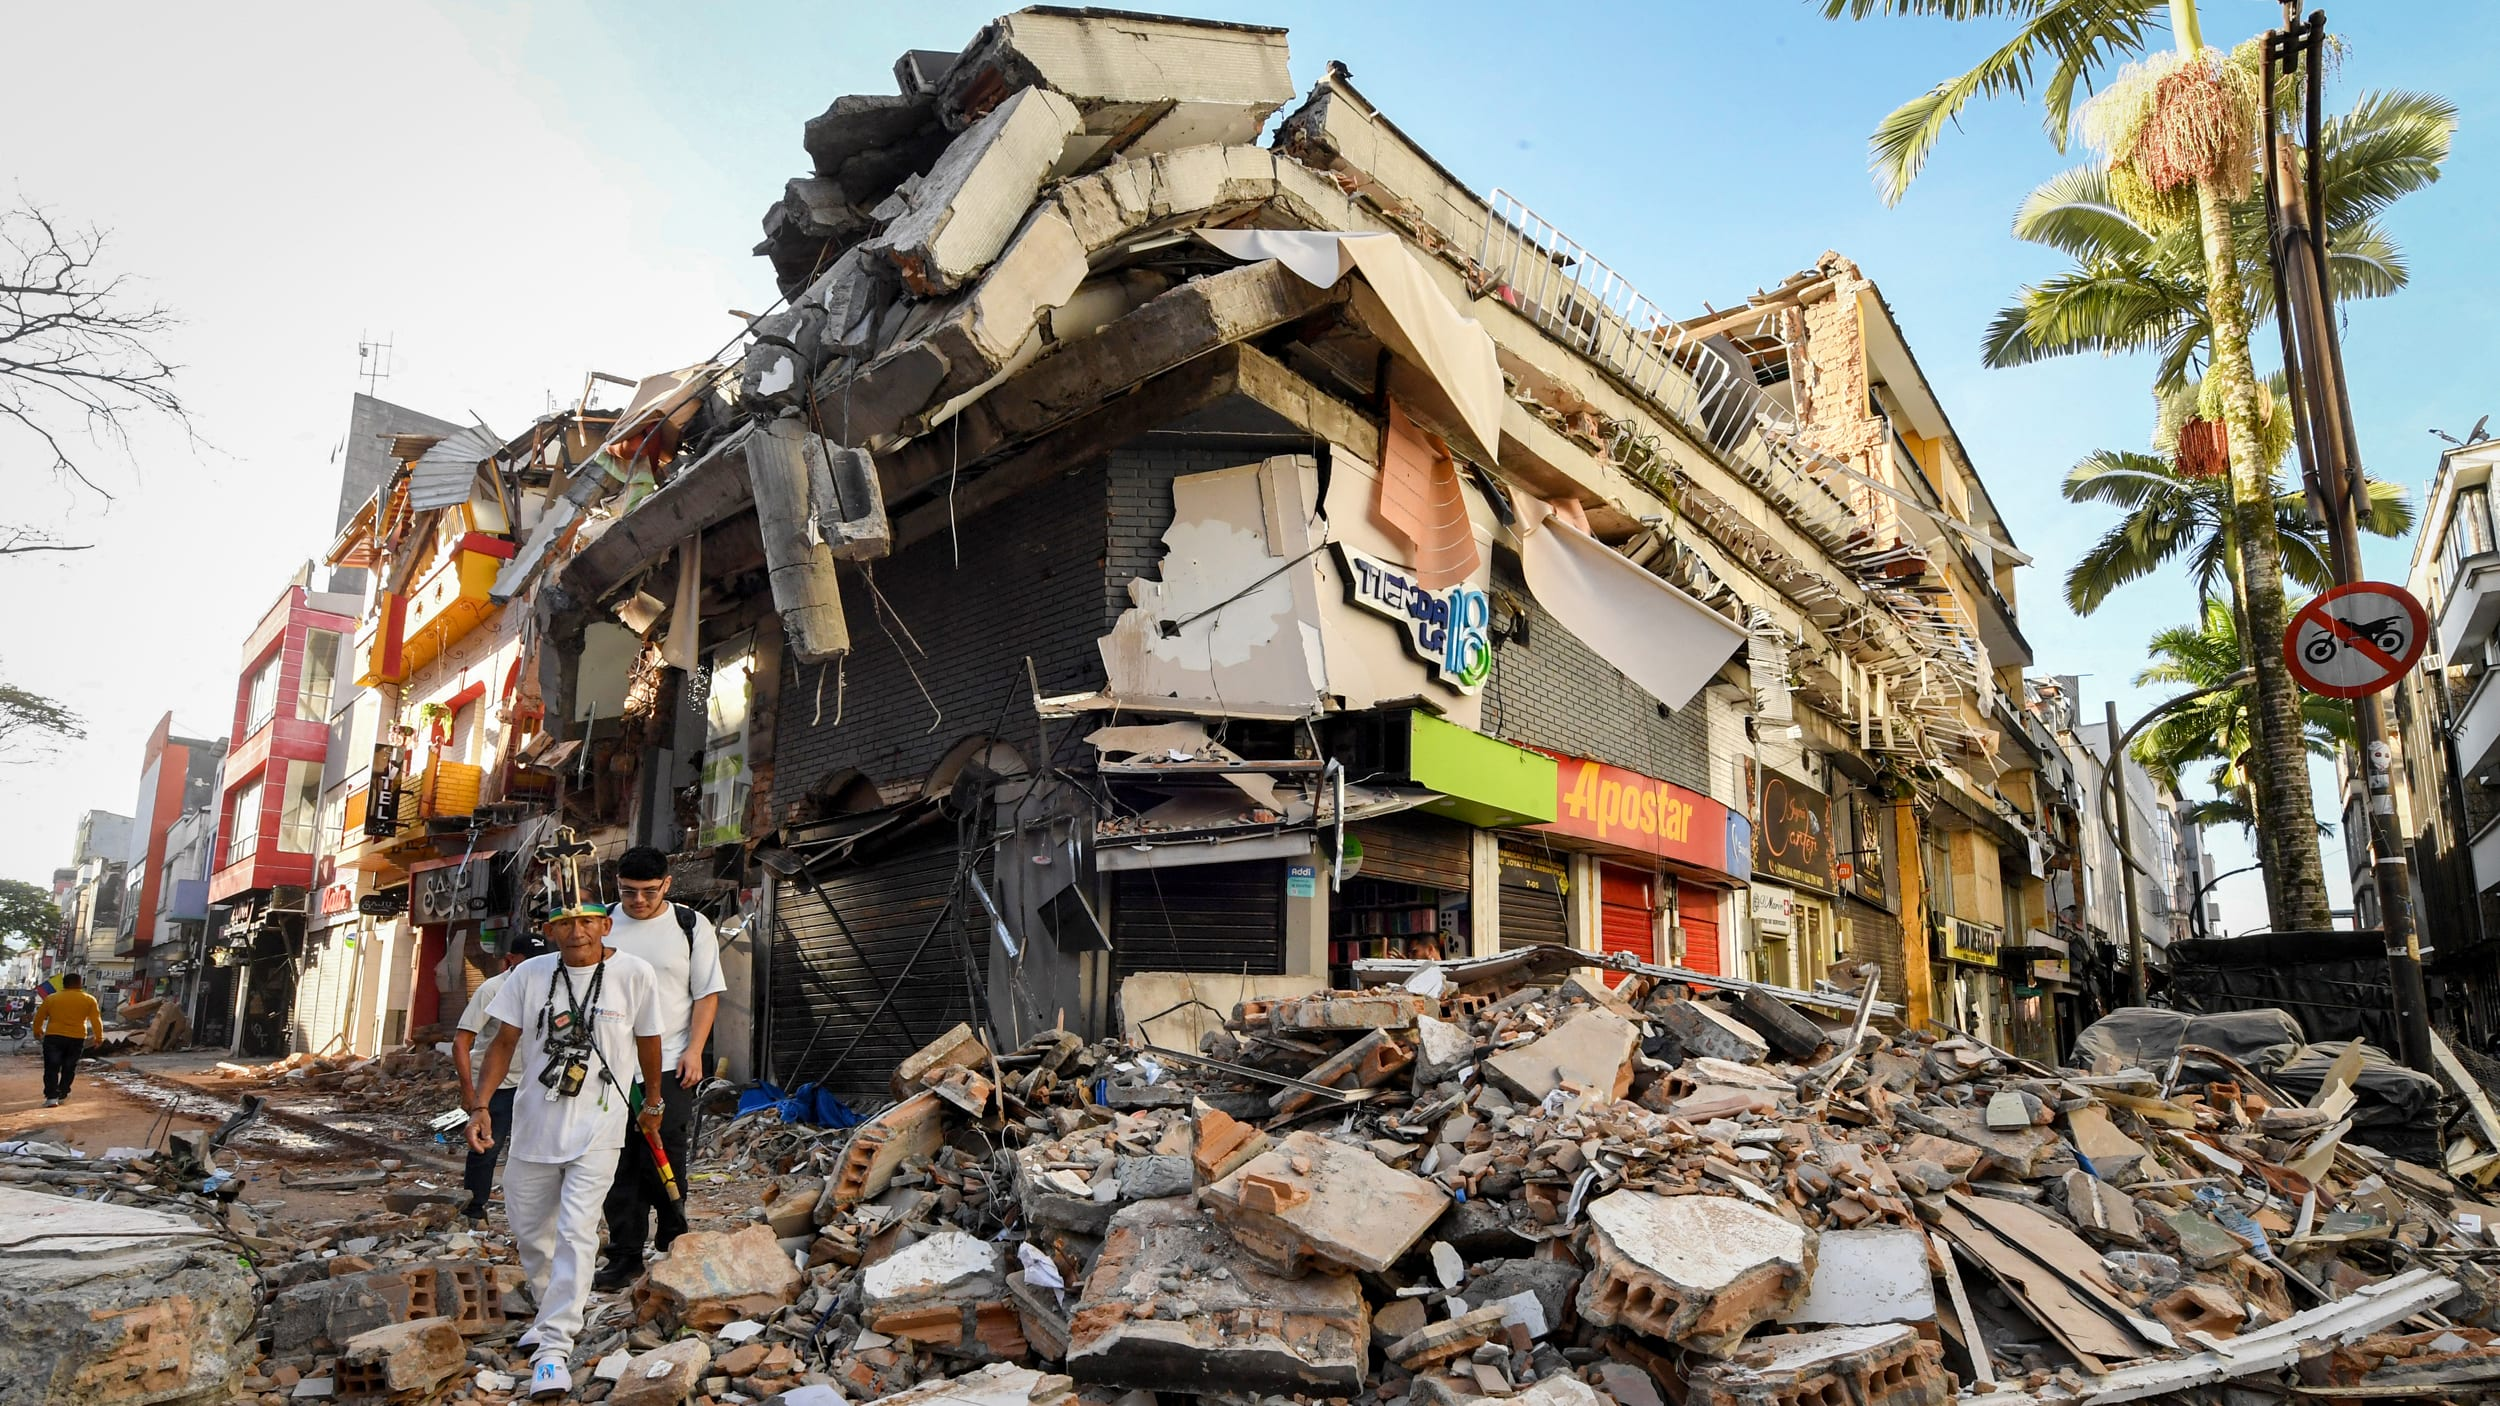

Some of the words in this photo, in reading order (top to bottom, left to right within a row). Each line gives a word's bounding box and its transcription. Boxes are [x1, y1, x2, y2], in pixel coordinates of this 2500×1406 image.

[1354, 558, 1449, 630] TIENDA
[1563, 761, 1693, 844] Apostar
[1292, 868, 1311, 876] Addi
[1506, 859, 1523, 868] JOYAS
[424, 868, 467, 915] SAU
[58, 922, 69, 957] HOTEL
